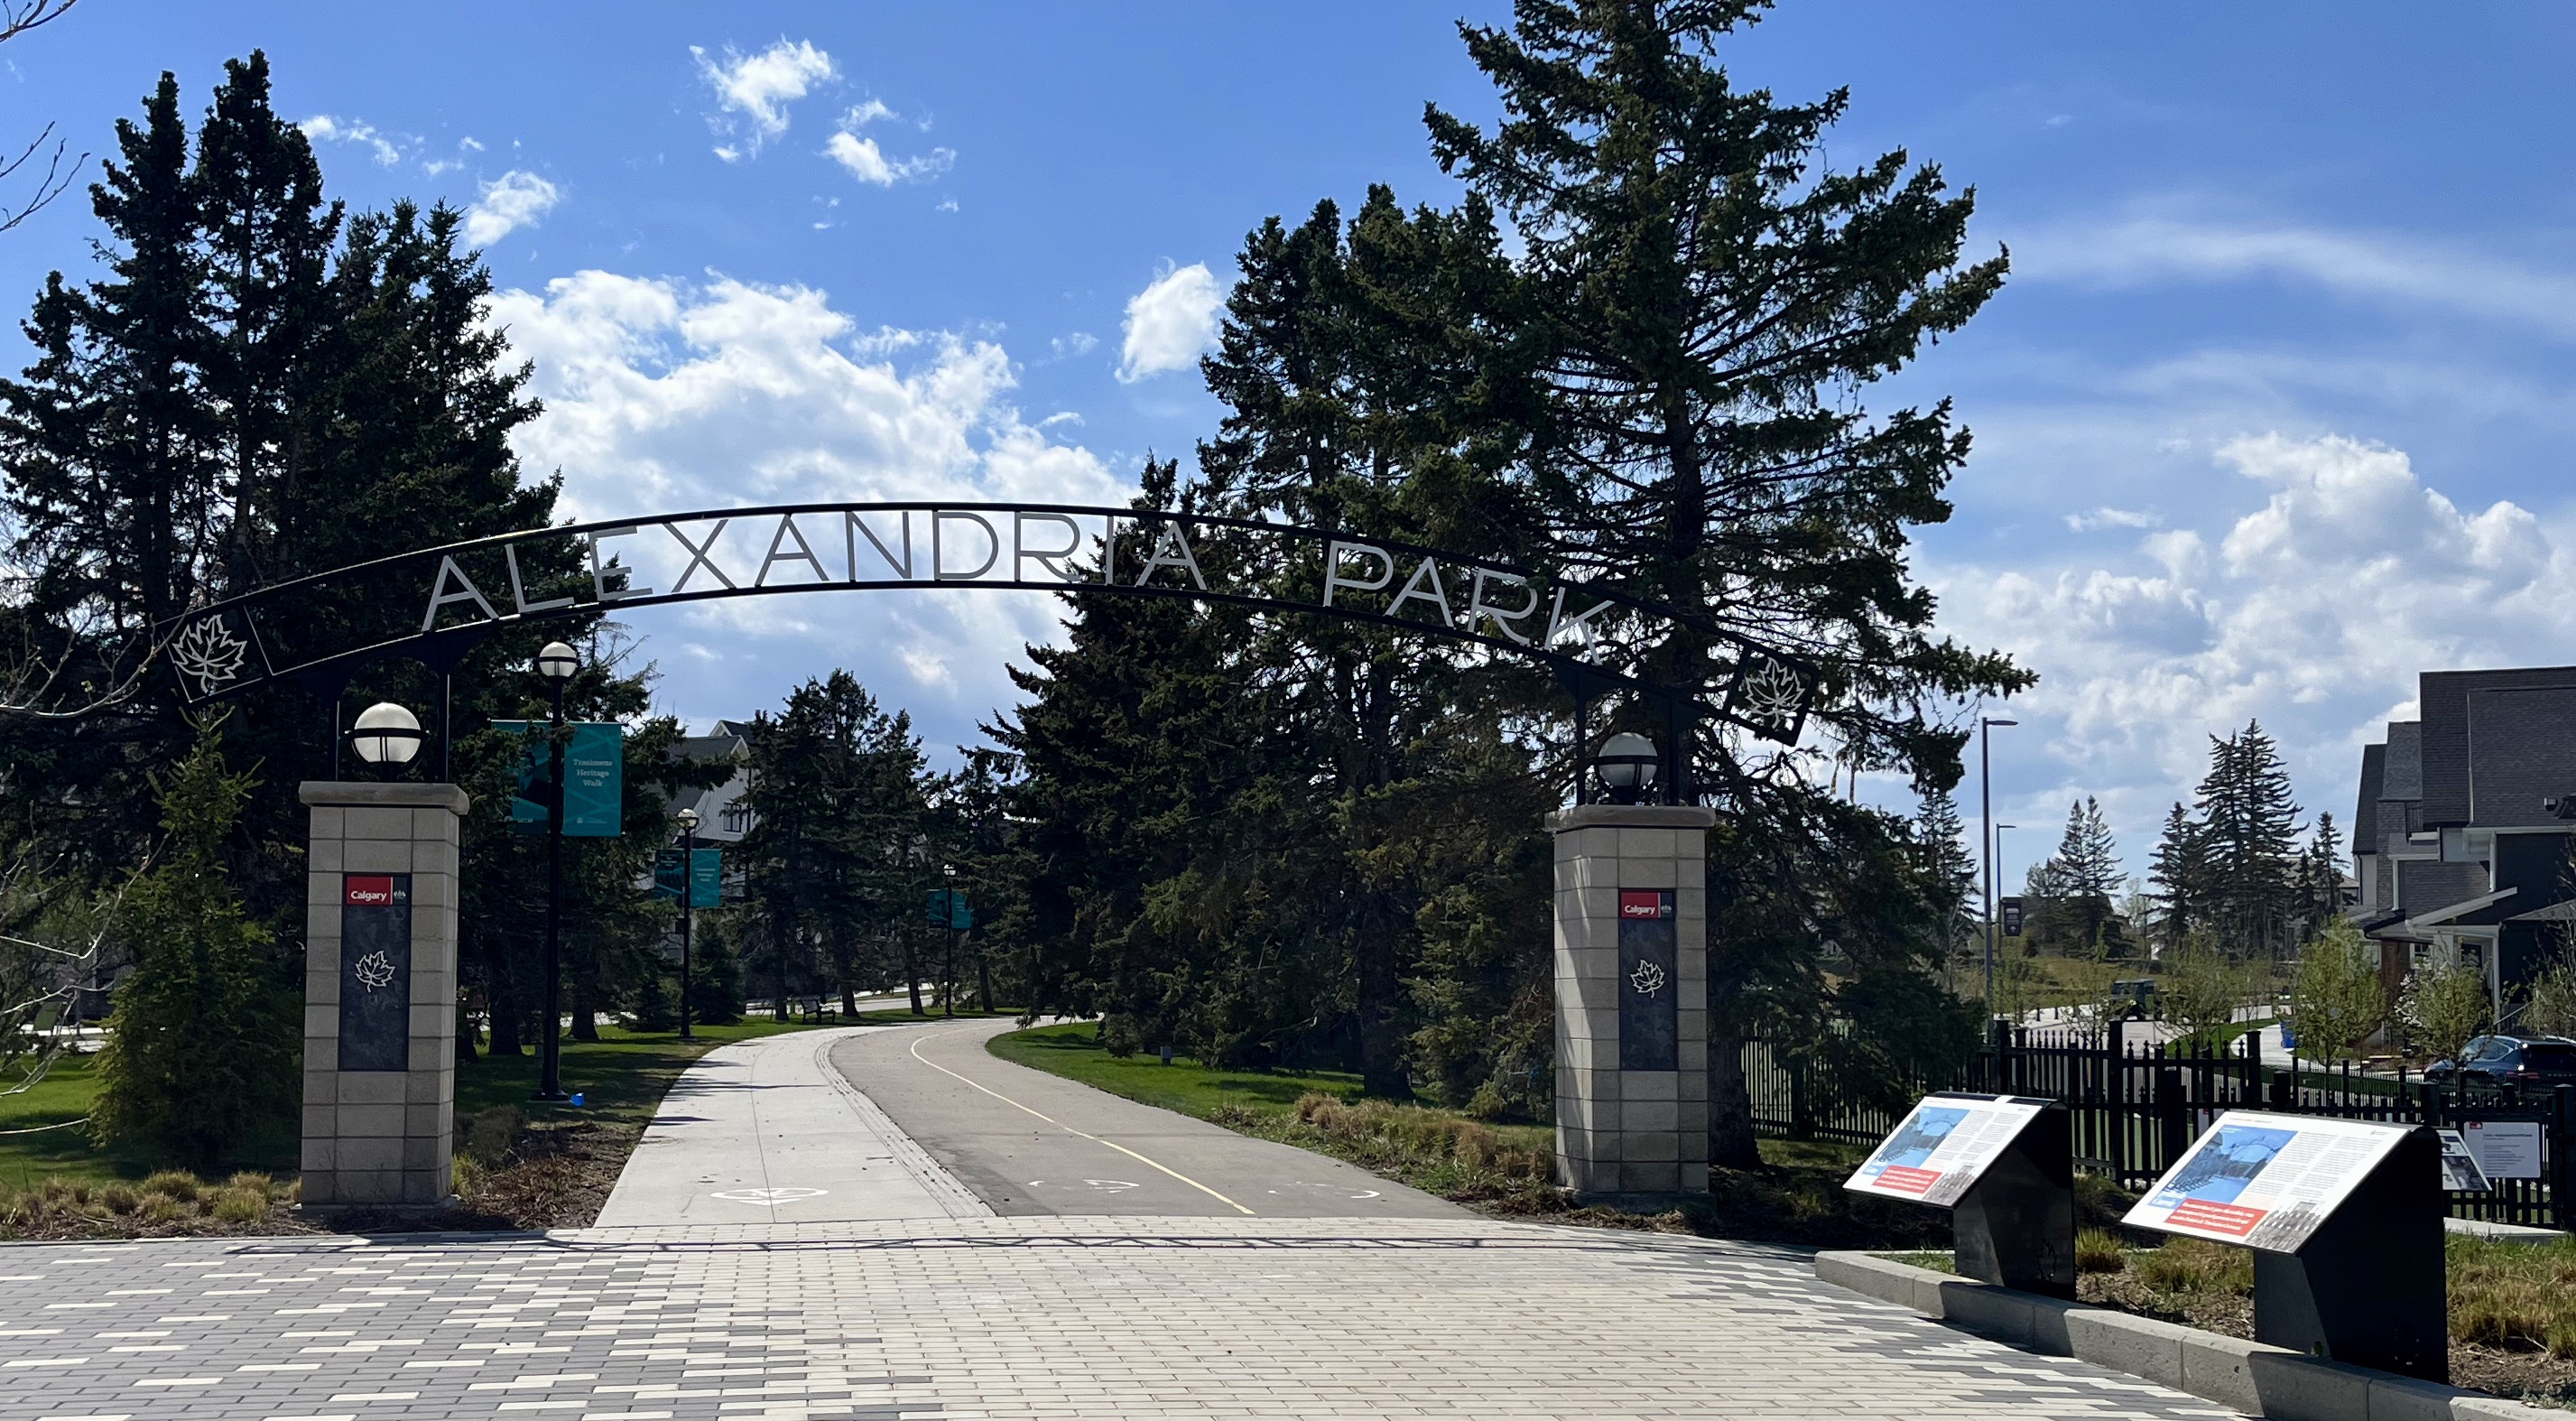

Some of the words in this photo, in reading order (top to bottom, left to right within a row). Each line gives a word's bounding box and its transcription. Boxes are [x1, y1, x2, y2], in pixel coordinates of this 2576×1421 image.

[421, 510, 1208, 632] ALEXANDRIA
[1322, 540, 1616, 666] PARK
[576, 768, 609, 778] Heritage
[350, 890, 387, 901] Calgary
[1624, 905, 1655, 915] Calgary
